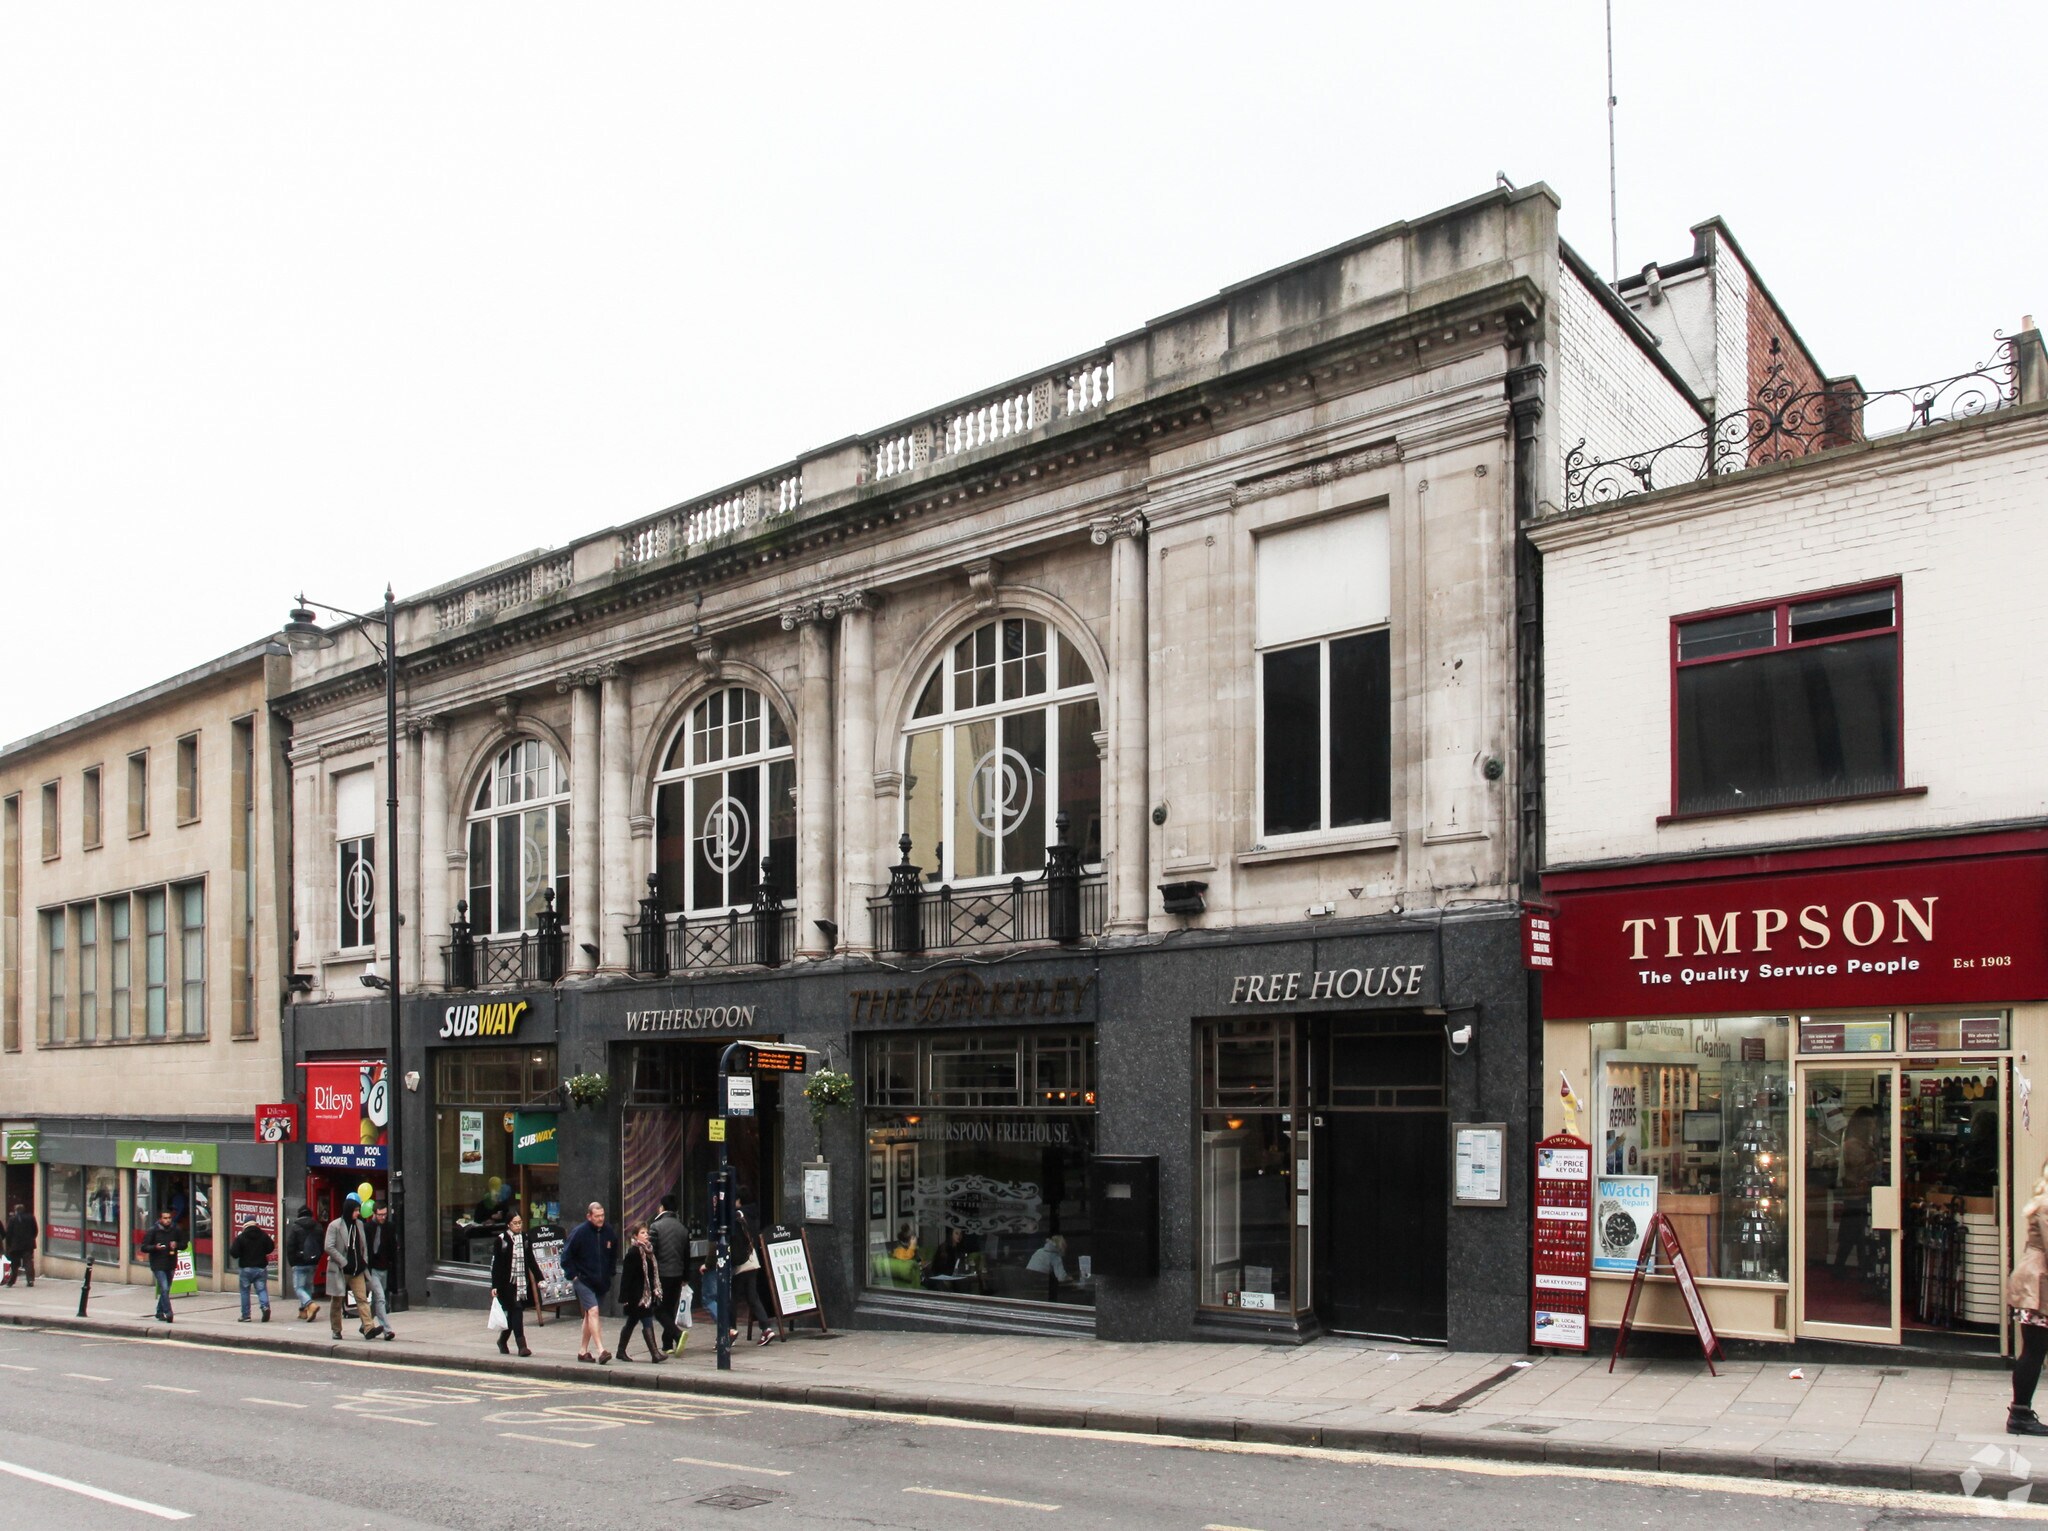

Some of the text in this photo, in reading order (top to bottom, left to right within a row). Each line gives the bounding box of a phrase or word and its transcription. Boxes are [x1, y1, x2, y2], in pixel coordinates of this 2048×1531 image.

[1622, 896, 1939, 960] TIMPSON
[1953, 956, 2012, 969] Est 1903
[1639, 957, 1921, 985] The Quality Service People
[1229, 964, 1425, 1004] FREE HOUSE
[849, 968, 1095, 1024] THE BERKELEY
[439, 1000, 528, 1039] SUBWAY
[626, 1005, 757, 1032] WETHERSPOON
[315, 1085, 353, 1119] Rileys
[1612, 1086, 1636, 1107] PHONE
[266, 1107, 288, 1115] Rileys
[1609, 1108, 1637, 1128] REPAIRS
[517, 1128, 557, 1149] SUBWAY
[997, 1123, 1070, 1143] FREEHOUSE
[1548, 1137, 1577, 1146] TIMPSON
[314, 1145, 381, 1155] BINGO BAR POOL
[320, 1156, 376, 1167] SNOOKER DARTS
[1600, 1182, 1650, 1198] Watch
[234, 1203, 275, 1214] BASEMENT STOCK
[1622, 1199, 1650, 1207] Repairs
[234, 1212, 275, 1227] CLEANCE
[773, 1245, 801, 1258] FOOD
[777, 1262, 804, 1274] UNTIL
[797, 1275, 807, 1283] PM
